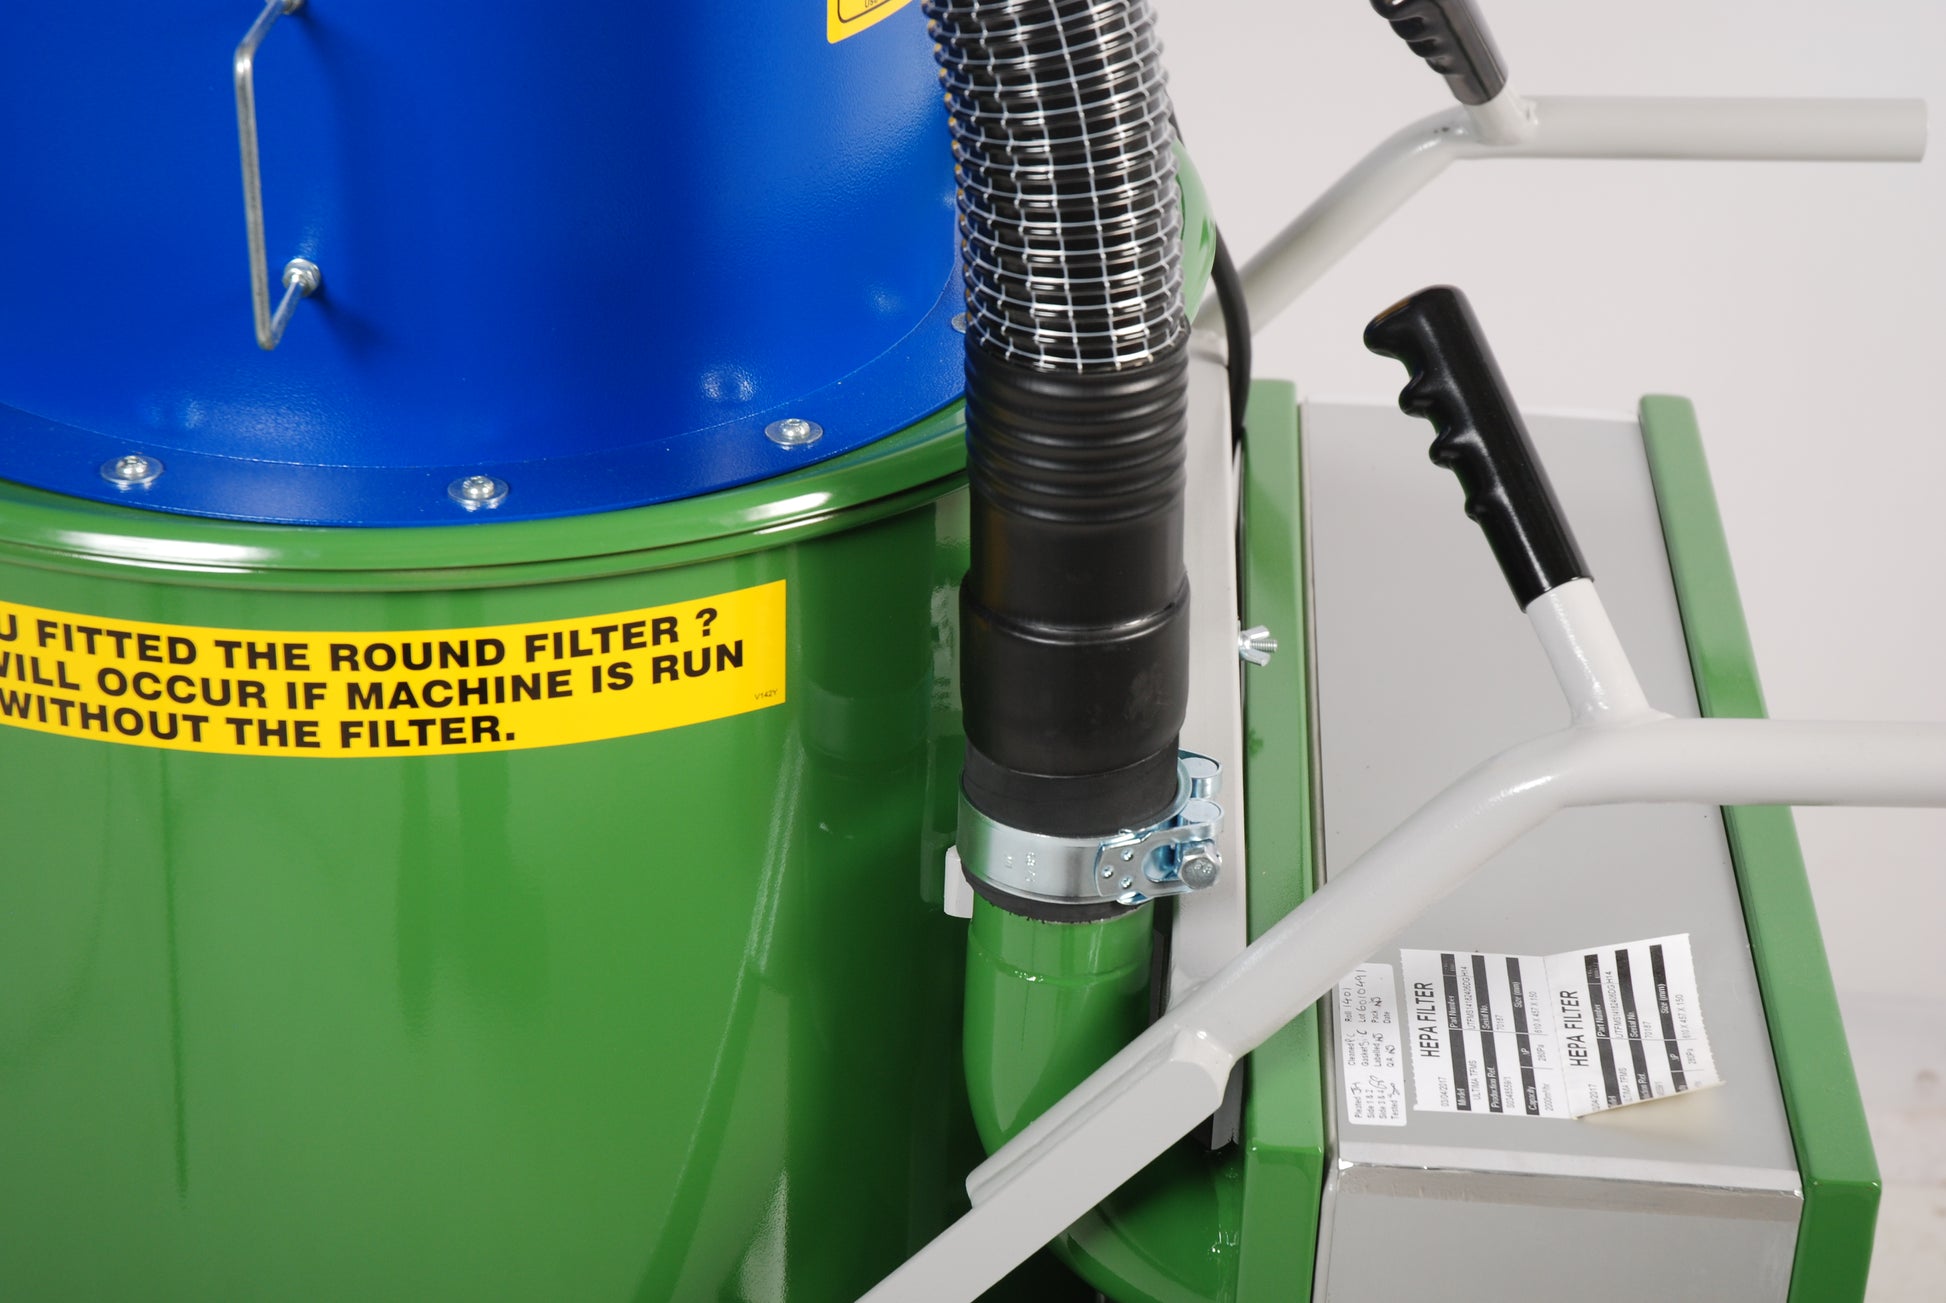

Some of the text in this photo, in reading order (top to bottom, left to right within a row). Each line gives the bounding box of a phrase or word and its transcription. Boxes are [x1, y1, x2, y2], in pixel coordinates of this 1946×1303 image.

[37, 619, 197, 665] FITTED
[215, 640, 310, 671] THE
[330, 638, 506, 672] ROUND
[525, 616, 678, 663] FILTER
[695, 607, 718, 637] ?
[97, 667, 266, 708] OCCUR
[287, 682, 327, 709] IF
[347, 669, 572, 710] MACHINE
[592, 661, 633, 693] IS
[651, 639, 743, 684] RUN
[0, 688, 515, 748] WITHOUT THE FILTER.
[1605, 971, 1613, 983] H14
[1512, 982, 1522, 1008] Size (mm)
[1657, 984, 1669, 1014] Size (mm)
[1343, 1010, 1352, 1022] Roll
[1357, 1012, 1366, 1022] Lot
[1369, 1009, 1379, 1023] Pack
[1382, 1011, 1391, 1023] Date
[1413, 981, 1440, 1057] HEPA FILTER
[1448, 996, 1458, 1028] Part Number
[1480, 1003, 1490, 1029] Serial No.
[1594, 1004, 1606, 1036] Part Number
[1559, 991, 1589, 1067] HEPA FILTER
[1626, 1011, 1638, 1037] Serial No.
[1345, 1042, 1357, 1065] Cleaned
[1359, 1046, 1369, 1065] Gasket
[1370, 1043, 1382, 1066] Labelled
[1457, 1088, 1466, 1106] Model
[1471, 1078, 1480, 1100] ULTIMA
[1487, 1066, 1500, 1108] Production Ref.
[1526, 1086, 1537, 1110] Capacity
[1352, 1096, 1363, 1118] Pleated
[1366, 1105, 1375, 1118] Side
[1378, 1106, 1387, 1118] Side
[1389, 1100, 1399, 1119] Tested
